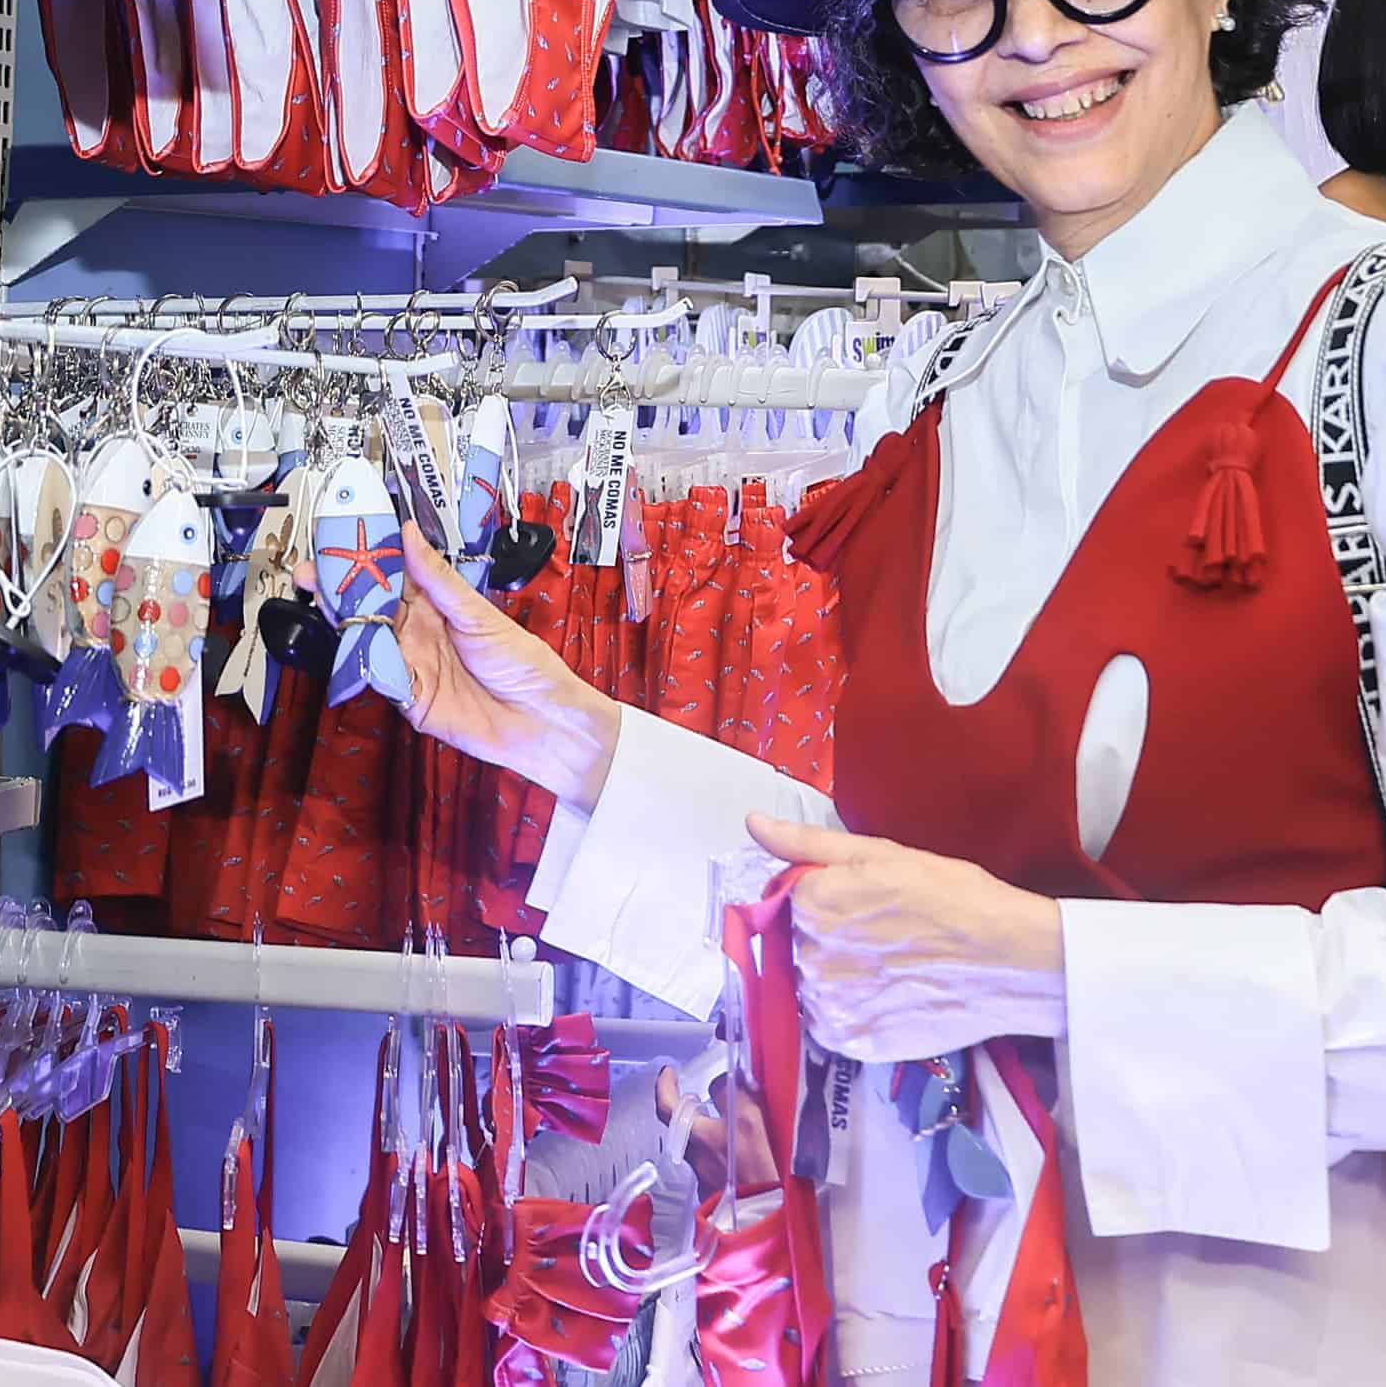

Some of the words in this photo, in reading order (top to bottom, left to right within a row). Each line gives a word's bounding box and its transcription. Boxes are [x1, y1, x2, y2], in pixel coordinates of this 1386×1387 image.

[1318, 331, 1356, 464] KARL
[399, 397, 416, 420] NO
[408, 424, 427, 451] ME
[418, 453, 446, 510] COMAS
[609, 454, 624, 476] ME
[613, 430, 627, 450] NO
[604, 479, 621, 529] COMAS
